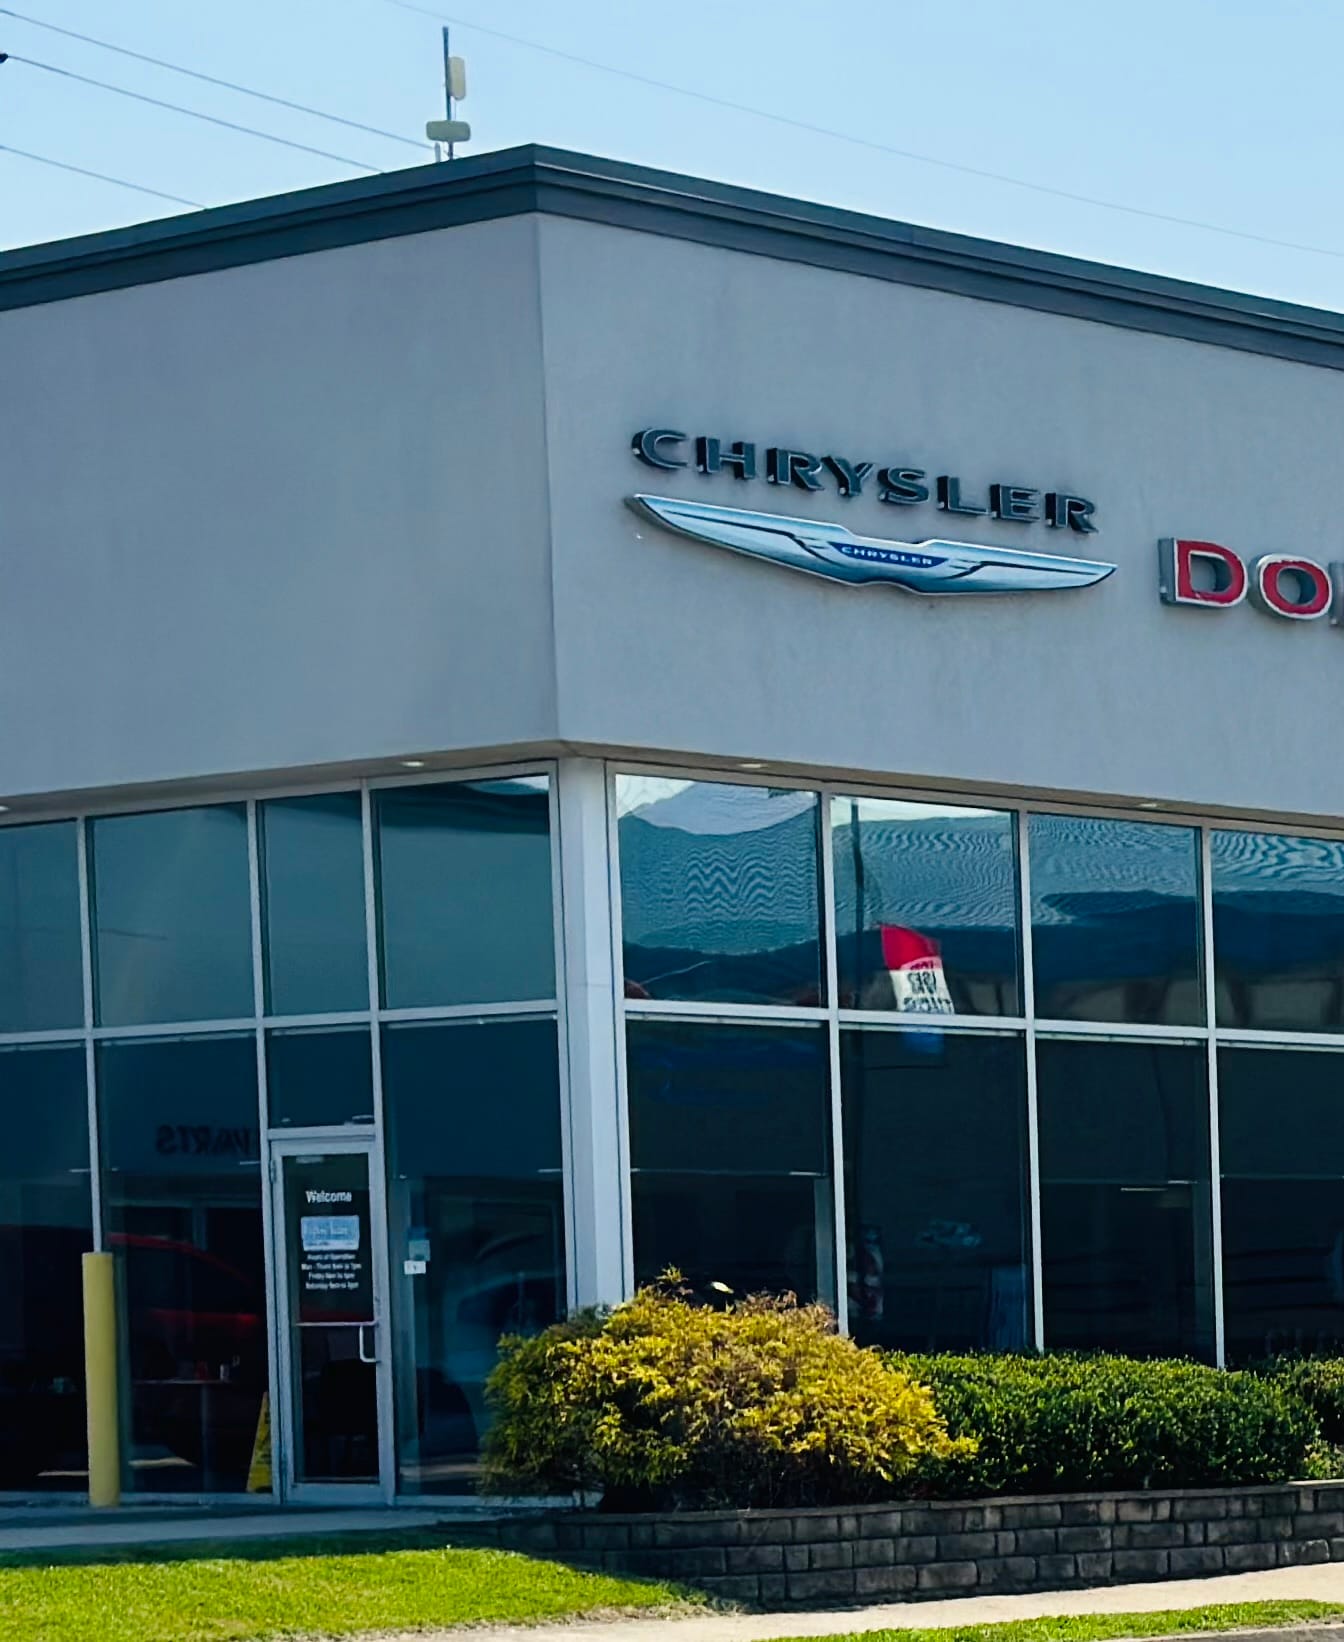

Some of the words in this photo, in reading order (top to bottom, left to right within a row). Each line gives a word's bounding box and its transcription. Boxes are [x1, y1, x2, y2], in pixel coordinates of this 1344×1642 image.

[631, 427, 1098, 534] CHRYSLER
[841, 546, 932, 565] CHRYSLER
[305, 1190, 353, 1204] Welcome
